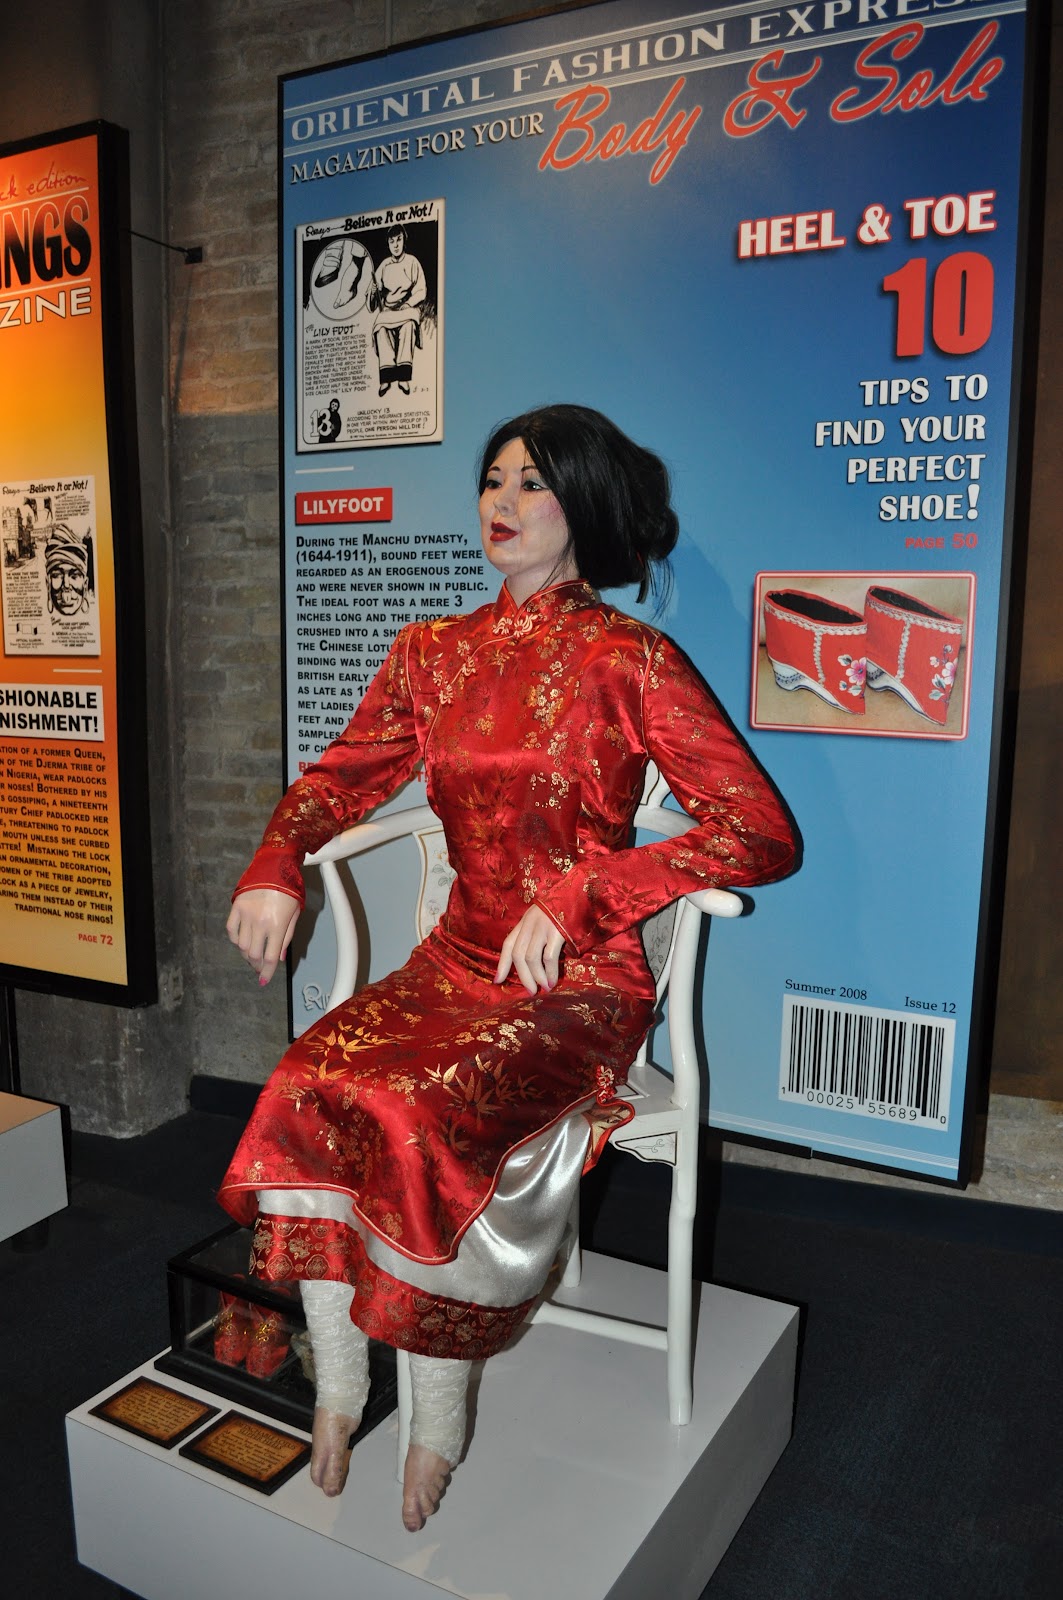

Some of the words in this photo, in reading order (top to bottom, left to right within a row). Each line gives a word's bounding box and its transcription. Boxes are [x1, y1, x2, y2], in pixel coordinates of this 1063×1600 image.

[291, 76, 495, 142] ORIENTAL
[512, 23, 725, 94] FASHION
[750, 0, 985, 44] EXPR
[290, 139, 410, 185] MAGAZINE
[416, 128, 467, 159] FOR
[473, 112, 545, 146] YOUR
[537, 76, 701, 185] Body
[723, 49, 822, 138] &
[830, 20, 1004, 122] Sole
[346, 215, 382, 231] Believe
[385, 211, 394, 224] It
[396, 211, 407, 221] or
[408, 203, 434, 219] Not!
[738, 209, 846, 259] HEEL
[857, 203, 892, 245] &
[904, 189, 997, 239] TOE
[0, 195, 92, 289] NGS
[0, 286, 91, 328] ZINE
[883, 251, 995, 357] 10
[860, 377, 929, 406] TIPS
[945, 373, 988, 401] TO
[815, 419, 885, 447] FIND
[900, 414, 986, 443] YOUR
[847, 454, 986, 483] PERFECT
[30, 484, 55, 494] Believe
[56, 482, 63, 492] It
[64, 483, 72, 491] or
[72, 480, 88, 491] Not!
[303, 496, 384, 516] LILYFOOT
[879, 483, 980, 521] SHOE!
[296, 536, 335, 547] DURING
[339, 537, 358, 546] THE
[362, 534, 410, 546] MANCHU
[414, 534, 468, 545] DYNASTY,
[905, 537, 945, 548] PAGE
[952, 532, 978, 549] 50
[296, 549, 376, 565] (1644-1911),
[381, 552, 417, 560] BOUND
[422, 551, 447, 560] FEET
[452, 550, 482, 559] WERE
[296, 568, 347, 577] REGARDED
[351, 568, 364, 576] AS
[368, 568, 382, 576] AN
[386, 567, 450, 576] EROGENOUS
[454, 566, 484, 575] ZONE
[296, 584, 316, 592] AND
[320, 583, 346, 591] WERE
[351, 583, 383, 591] NEVER
[388, 582, 424, 591] SHOWN
[429, 582, 440, 591] IN
[445, 582, 488, 591] PUBLIC.
[296, 596, 317, 607] THE
[322, 598, 349, 607] IDEAL
[353, 598, 379, 607] FOOT
[382, 598, 405, 607] WAS
[409, 598, 416, 607] A
[421, 598, 450, 607] MERE
[454, 595, 463, 607] 3
[296, 613, 331, 622] INCHES
[335, 613, 362, 622] LONG
[366, 614, 386, 622] AND
[391, 613, 411, 622] THE
[415, 614, 442, 622] FOOT
[297, 628, 341, 636] CRUSHED
[345, 628, 368, 637] INTO
[372, 629, 379, 637] A
[297, 642, 316, 650] THE
[319, 640, 364, 652] CHINESE
[368, 644, 393, 652] LOTU
[297, 658, 336, 666] BINDING
[340, 658, 361, 667] WAS
[298, 672, 334, 681] BRITISH
[339, 673, 369, 682] EARLY
[298, 686, 310, 695] AS
[313, 687, 336, 696] LATE
[340, 688, 353, 697] AS
[298, 700, 317, 709] MET
[321, 701, 354, 711] LADIES
[0, 712, 98, 733] NISHMENT!
[298, 715, 320, 724] FEET
[324, 716, 344, 726] AND
[298, 730, 340, 739] SAMPLES
[41, 748, 71, 758] FORMER
[74, 748, 106, 761] QUEEN,
[298, 744, 310, 752] OF
[7, 758, 16, 766] OF
[19, 759, 33, 768] THE
[36, 758, 68, 770] DJERMA
[70, 763, 93, 771] TRIBE
[6, 769, 40, 782] NIGERIA,
[43, 774, 64, 782] WEAR
[67, 775, 107, 785] PADLOCKS
[8, 782, 34, 792] NOSES!
[37, 783, 78, 796] BOTHERED
[81, 788, 91, 796] BY
[94, 790, 107, 798] HIS
[8, 795, 49, 808] GOSSIPING,
[60, 800, 108, 811] NINETEENTH
[21, 806, 43, 817] CHIEF
[46, 810, 90, 822] PADLOCKED
[93, 815, 108, 824] HER
[9, 820, 59, 832] THREATENING
[62, 824, 72, 833] TO
[74, 826, 109, 837] PADLOCK
[2, 831, 28, 840] MOUTH
[30, 834, 59, 843] UNLESS
[61, 837, 76, 846] SHE
[79, 839, 110, 849] CURBED
[27, 843, 69, 857] MISTAKING
[72, 850, 87, 859] THE
[90, 852, 110, 862] LOCK
[9, 856, 57, 868] ORNAMENTAL
[60, 862, 111, 876] DECORATION,
[36, 870, 49, 879] THE
[52, 872, 74, 882] TRIBE
[76, 876, 112, 887] ADOPTED
[19, 880, 28, 888] AS
[39, 883, 59, 892] PIECE
[62, 886, 72, 894] OF
[74, 888, 112, 901] JEWELRY,
[21, 892, 41, 902] THEM
[44, 896, 75, 906] INSTEAD
[90, 902, 113, 912] THEIR
[14, 903, 61, 917] TRADITIONAL
[64, 911, 84, 920] NOSE
[87, 914, 114, 924] RINGS!
[78, 933, 98, 943] PAGE
[100, 934, 113, 946] 72
[785, 979, 836, 996] Summer
[839, 986, 868, 1000] 2008
[904, 996, 938, 1011] Issue
[942, 1002, 956, 1014] 12
[807, 1091, 854, 1110] 00025
[868, 1102, 917, 1121] 55689
[940, 1116, 947, 1124] 0
